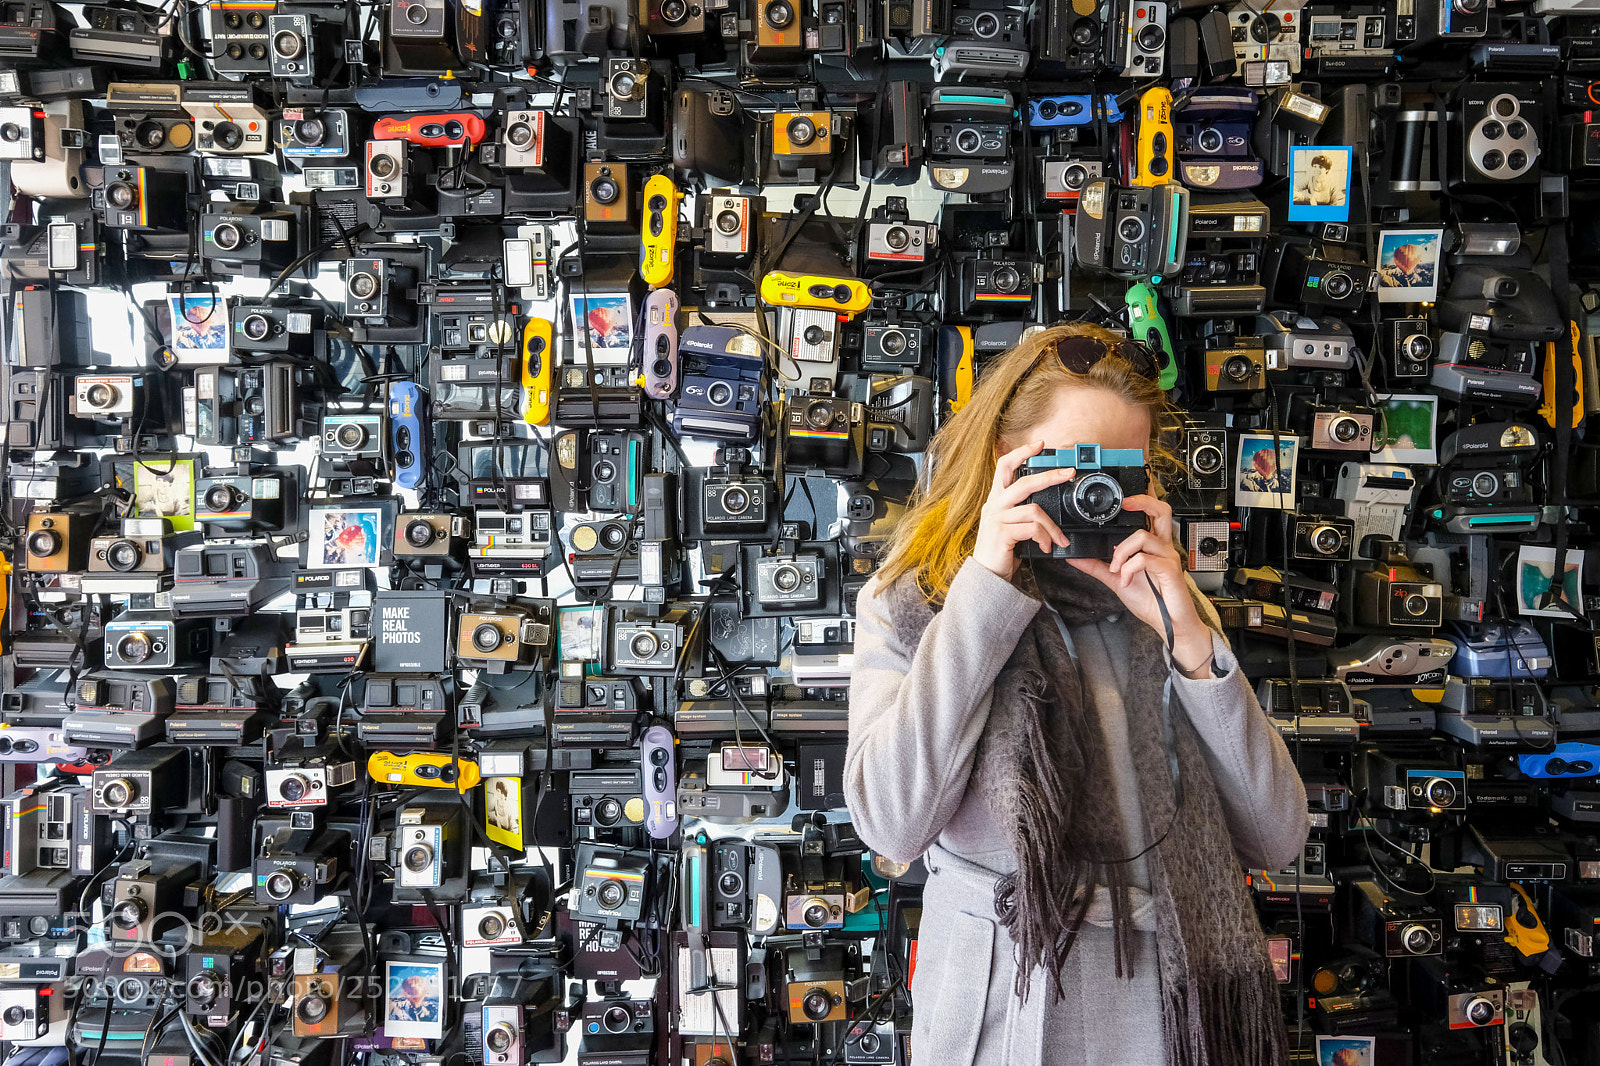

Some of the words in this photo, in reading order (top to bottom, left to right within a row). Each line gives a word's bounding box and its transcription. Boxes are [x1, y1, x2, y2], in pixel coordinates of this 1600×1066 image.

[294, 17, 300, 26] 88
[614, 107, 621, 115] 88
[126, 216, 132, 224] 10
[383, 607, 410, 618] MAKE
[383, 620, 407, 631] REAL
[383, 632, 420, 644] PHOTOS
